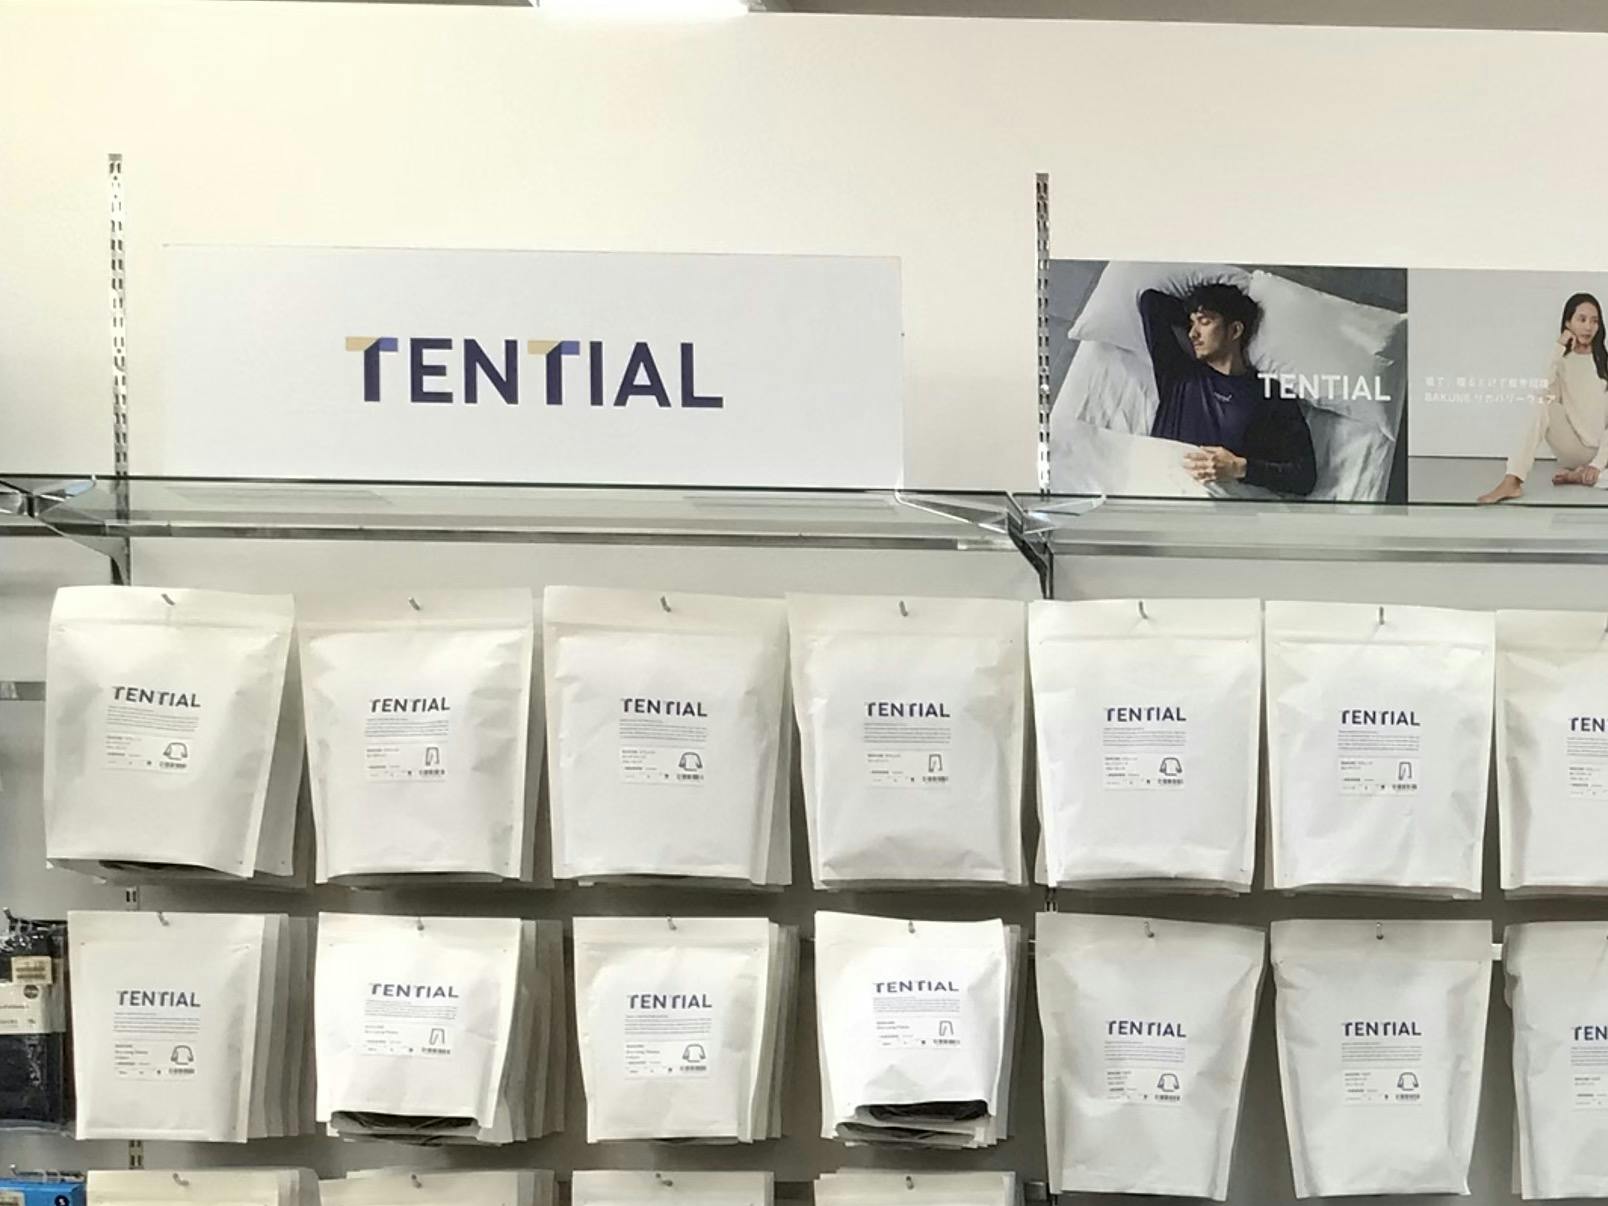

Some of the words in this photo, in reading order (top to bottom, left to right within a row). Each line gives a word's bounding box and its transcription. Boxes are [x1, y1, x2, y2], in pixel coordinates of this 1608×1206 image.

[345, 336, 723, 408] TENTIAL
[1257, 372, 1391, 401] TENTIAL
[111, 686, 201, 708] TENTIAL
[369, 696, 451, 713] TENTIAL
[621, 697, 708, 718] TENTIAL
[865, 701, 951, 718] TENTIAL
[1104, 706, 1187, 723] TENTIAL
[1339, 709, 1421, 727] TENTIAL
[369, 983, 460, 999] TENTIAL
[873, 979, 960, 994] TENTIAL
[117, 990, 201, 1008] TENTIAL
[627, 993, 713, 1010] TENTIAL
[1106, 1020, 1187, 1038] TENTIAL
[1340, 1021, 1422, 1037] TENTIAL
